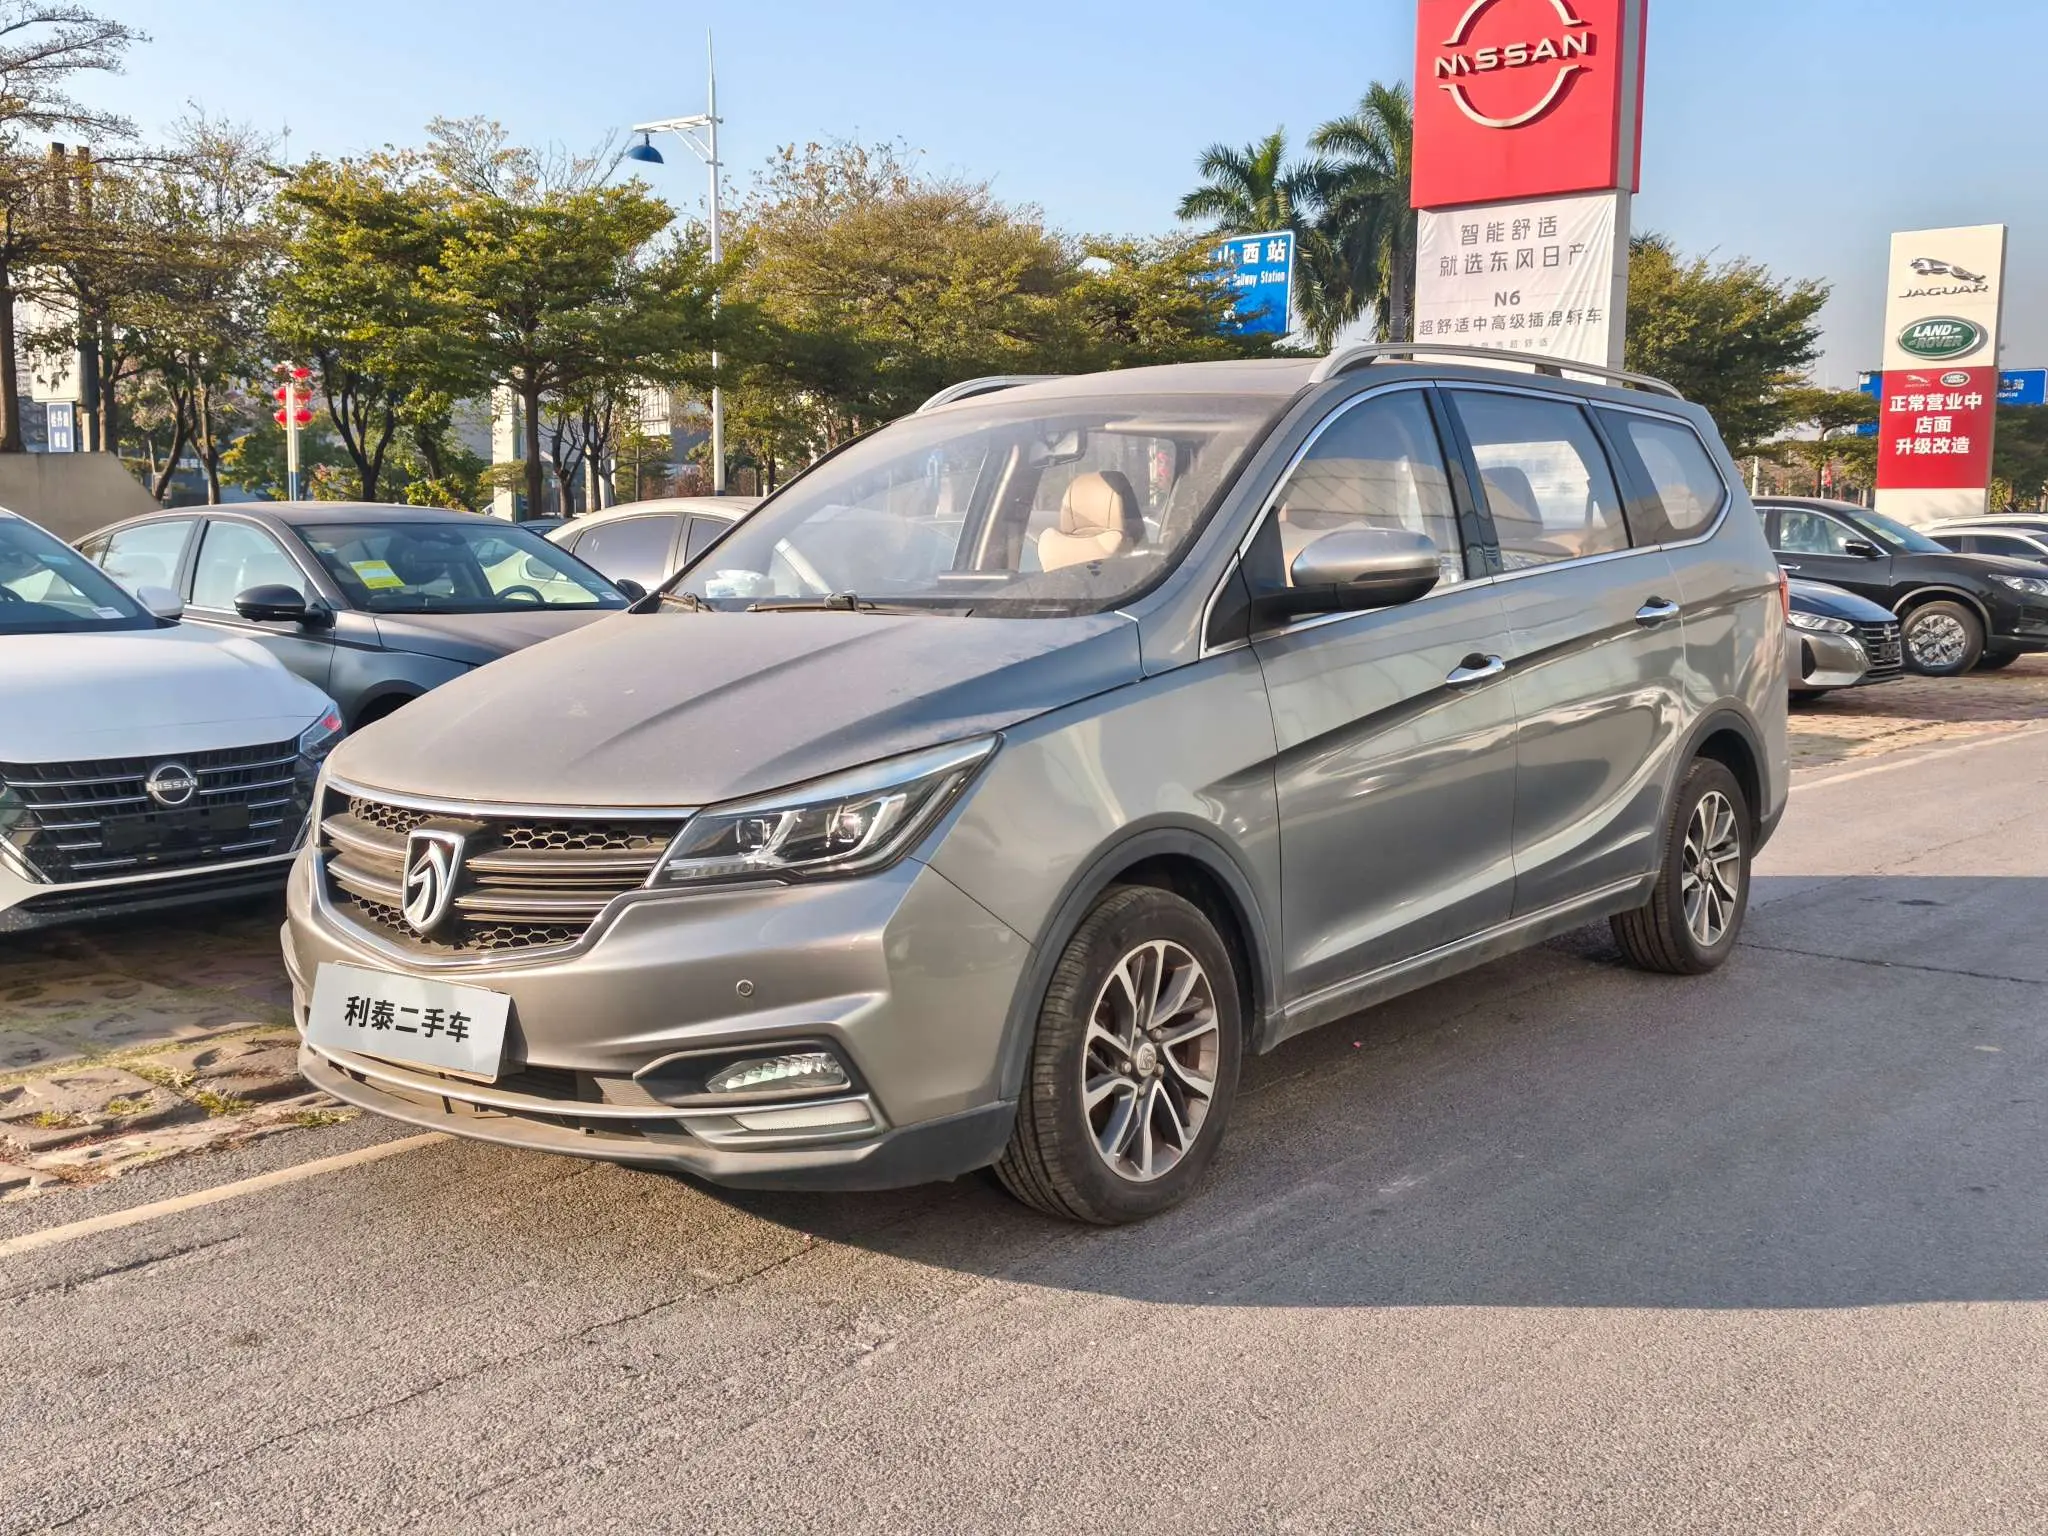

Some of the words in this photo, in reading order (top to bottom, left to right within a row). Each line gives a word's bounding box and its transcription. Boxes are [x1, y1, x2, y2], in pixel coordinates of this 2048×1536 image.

[1434, 31, 1590, 78] NISSAN
[1460, 215, 1558, 246] 智能舒适
[1439, 243, 1588, 277] 就选东风日产
[1260, 270, 1285, 284] Station
[1494, 290, 1521, 307] N6
[1899, 283, 1989, 298] JAGUAR
[1419, 307, 1602, 336] 超舒适中高级插混轿车
[1913, 324, 1953, 338] LAND
[1915, 336, 1964, 349] ROVER
[1889, 391, 1983, 413] 正常营业中
[1915, 415, 1952, 434] 店面
[1895, 436, 1970, 456] 升级改造
[146, 778, 198, 791] NISSAN
[344, 995, 472, 1043] 利泰二手车
